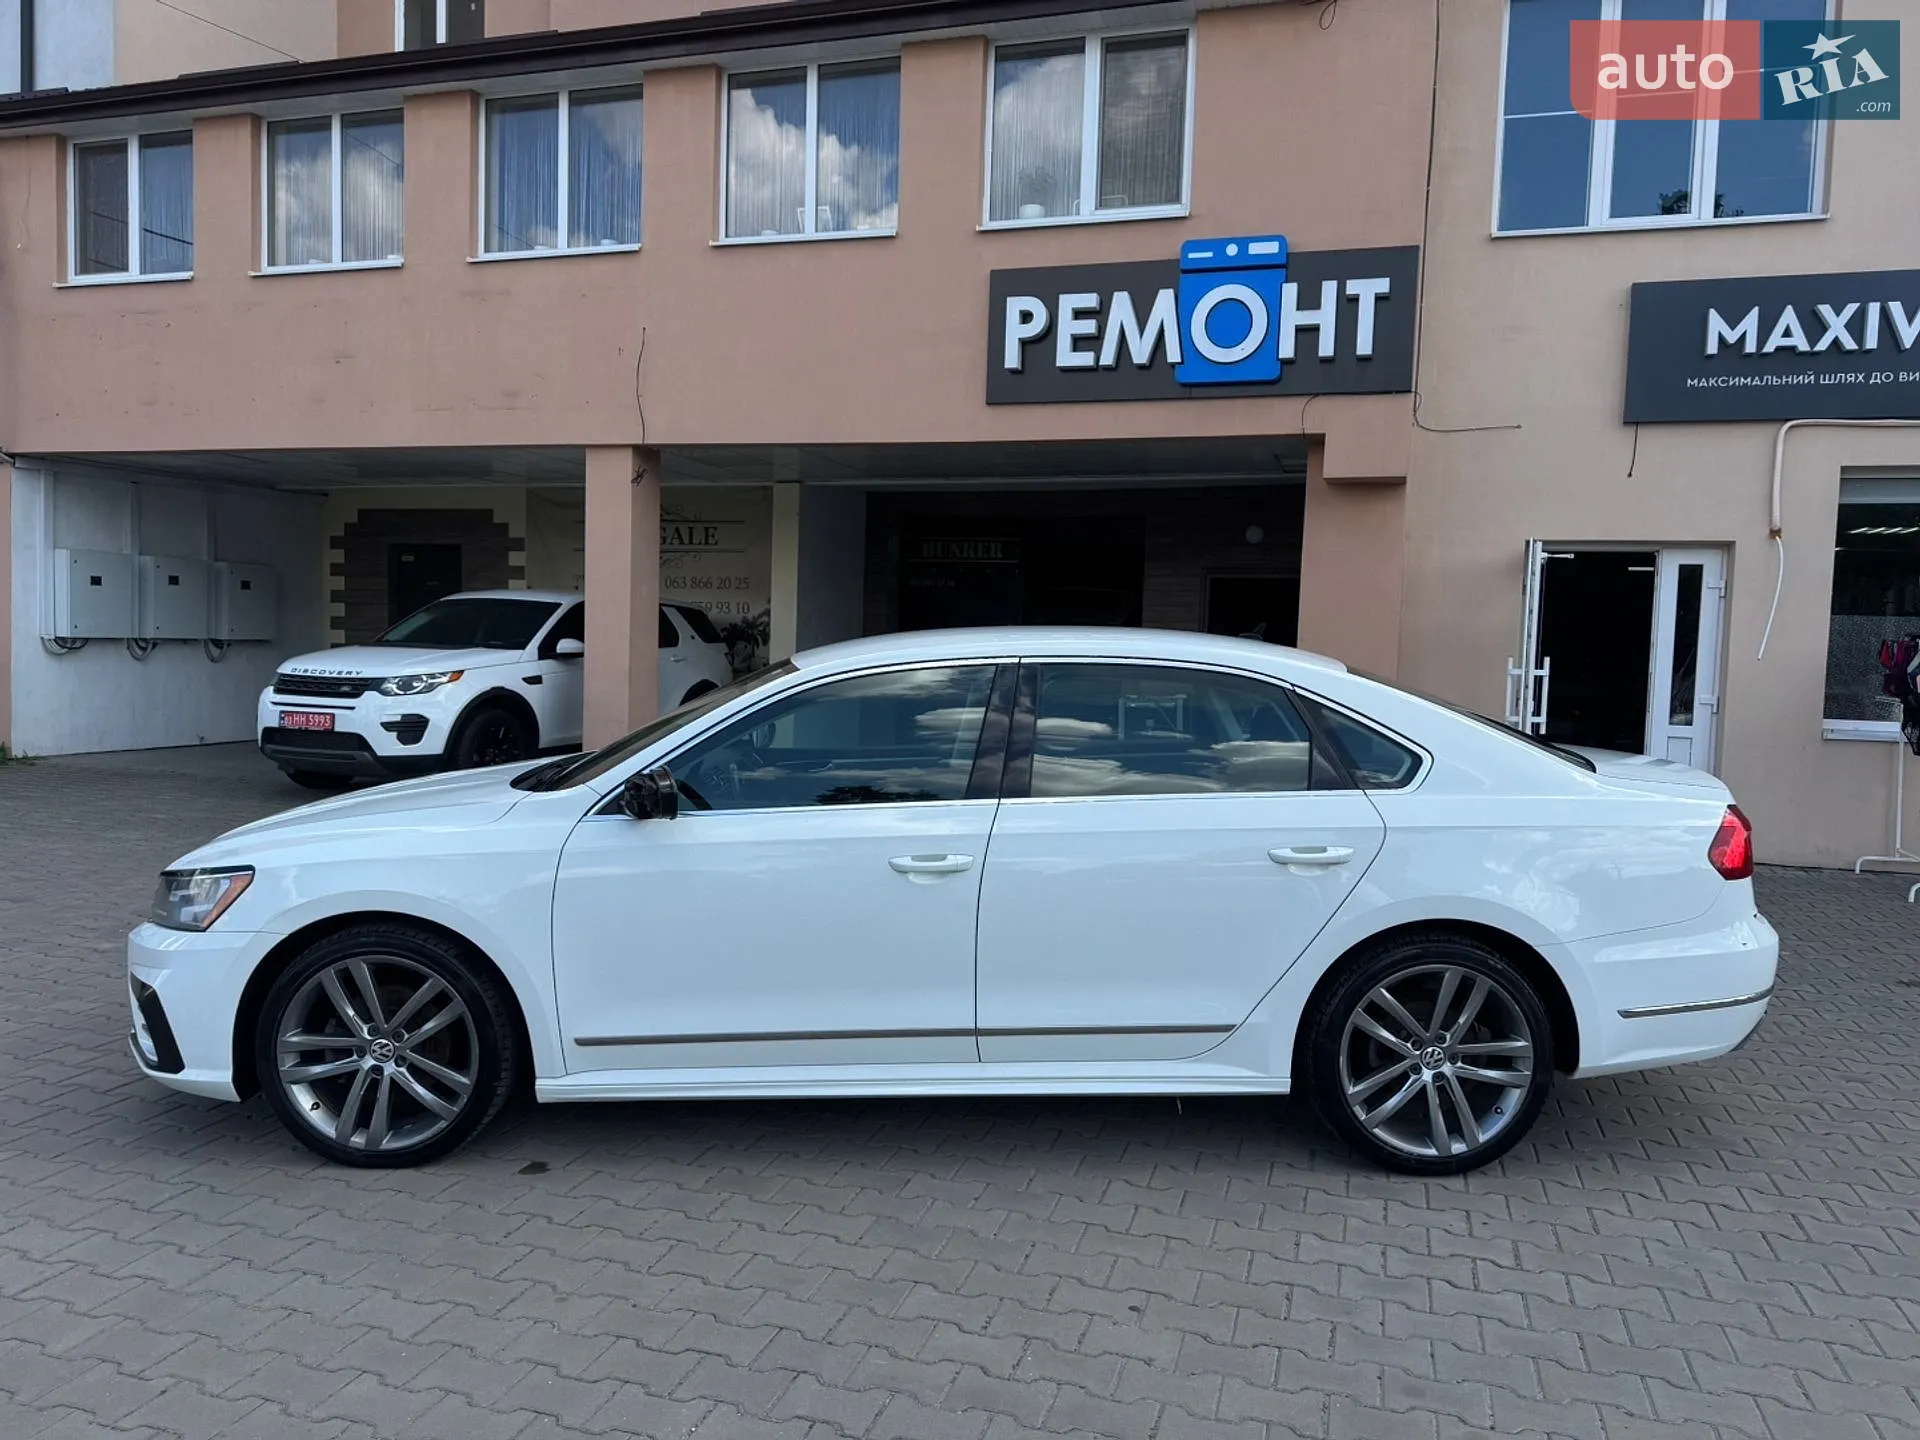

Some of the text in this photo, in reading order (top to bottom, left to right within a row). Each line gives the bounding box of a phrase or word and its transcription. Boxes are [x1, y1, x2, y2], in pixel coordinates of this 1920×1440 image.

[1003, 276, 1391, 372] РЕМОНТ
[1687, 371, 1815, 388] МАКСИМАЛЬНИЙ
[1819, 372, 1865, 384] ШЛЯХ
[1869, 372, 1894, 384] ДО
[664, 577, 687, 589] 063
[716, 577, 732, 589] 20
[735, 577, 750, 590] 25
[715, 601, 731, 614] 93
[736, 601, 750, 614] 10
[290, 667, 363, 676] DISCOVERY
